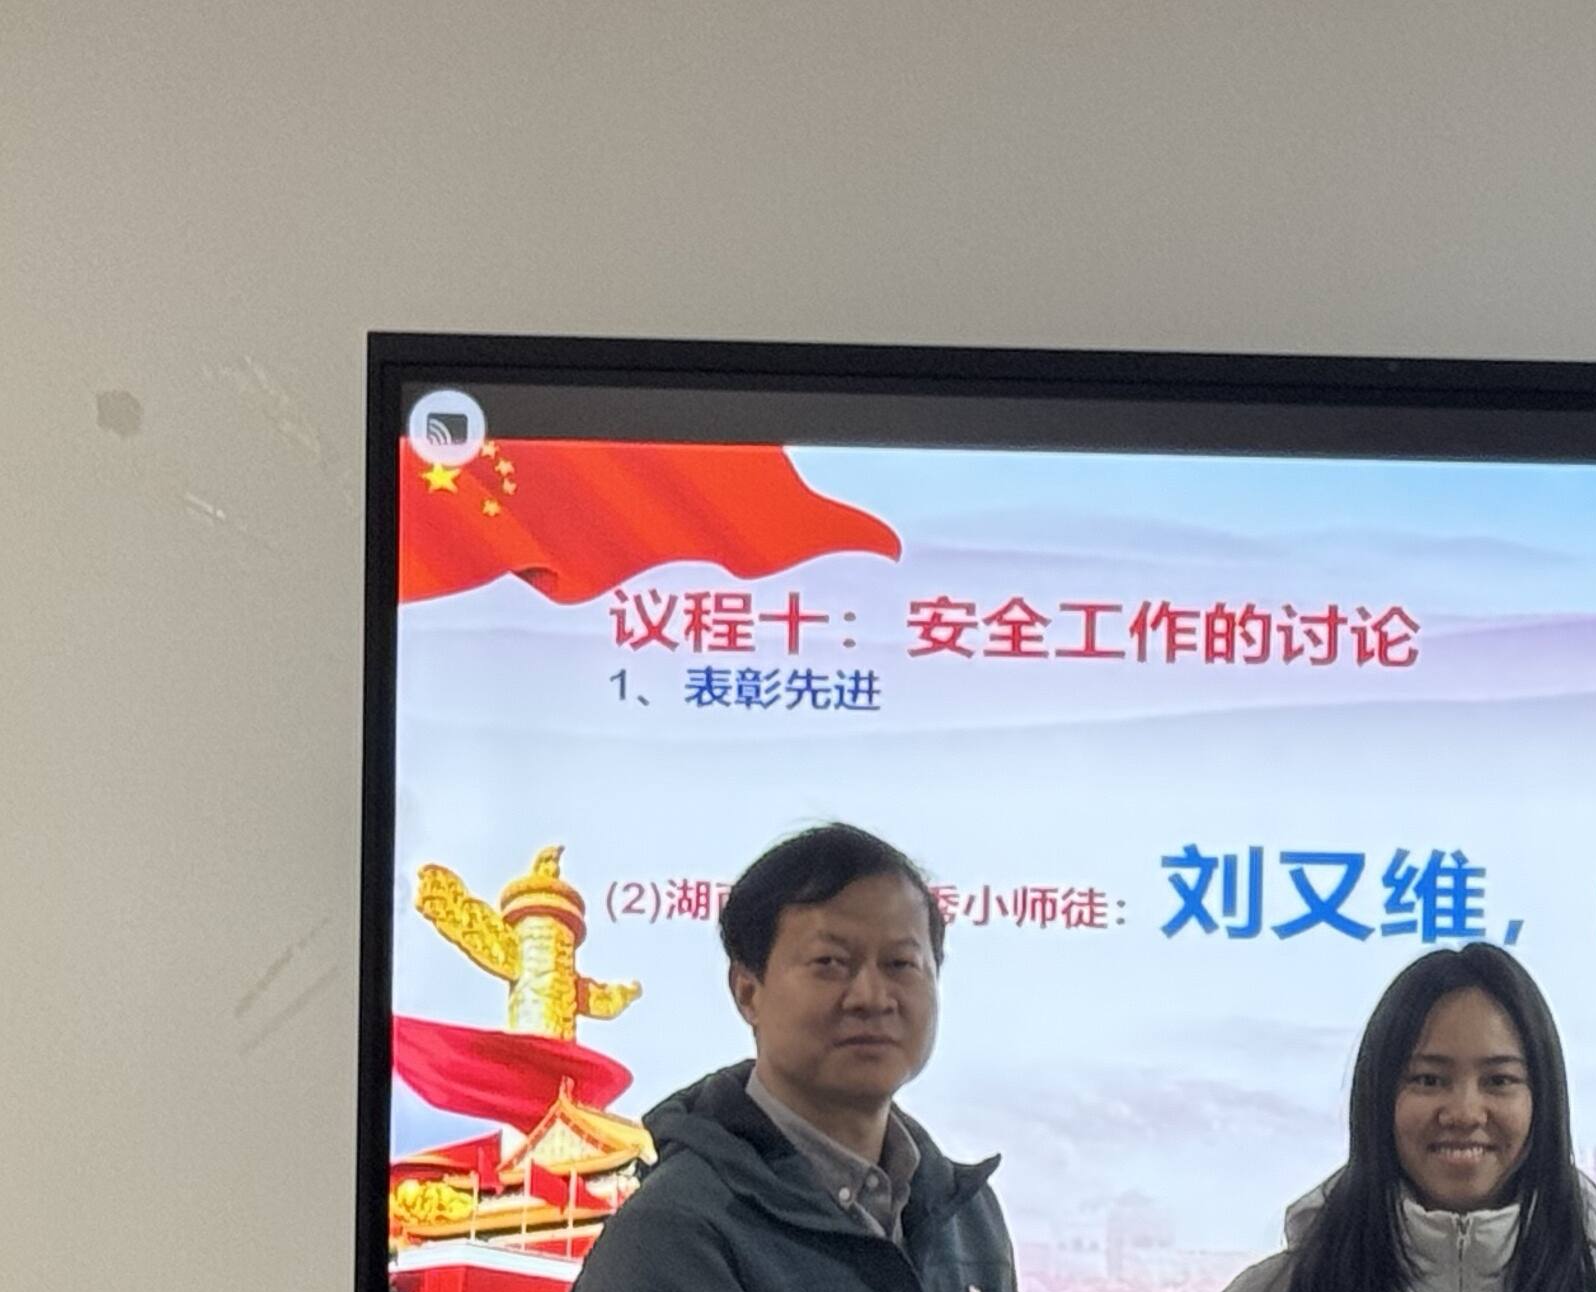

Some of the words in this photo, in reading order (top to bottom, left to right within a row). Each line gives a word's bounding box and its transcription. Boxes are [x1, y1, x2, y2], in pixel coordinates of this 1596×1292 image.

[609, 588, 1421, 667] 议程十：安全工作的讨论
[609, 665, 882, 711] 1、表彰先进
